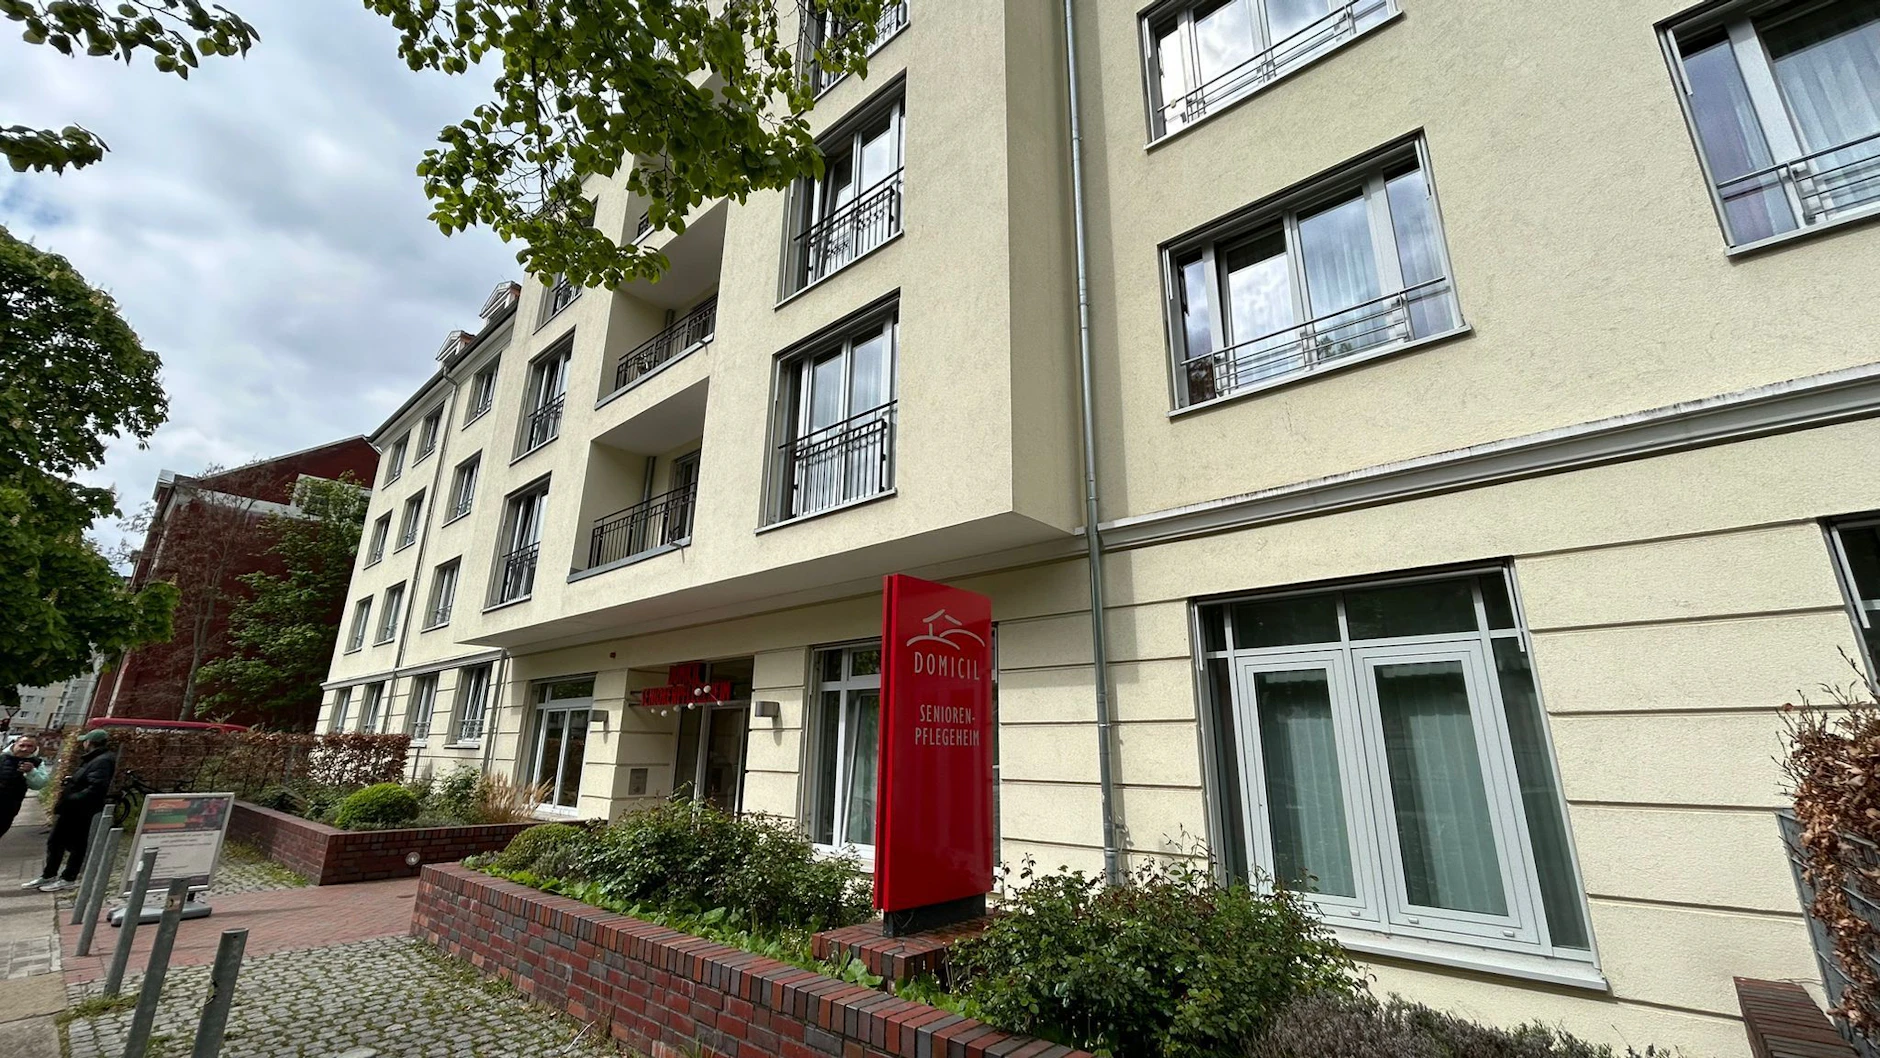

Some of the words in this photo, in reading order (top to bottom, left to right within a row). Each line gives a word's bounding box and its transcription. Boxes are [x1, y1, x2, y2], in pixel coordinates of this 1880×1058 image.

[914, 651, 979, 680] DOMICIL
[919, 704, 975, 724] SENIOREN-
[914, 727, 980, 747] PFLEGEHEIM
